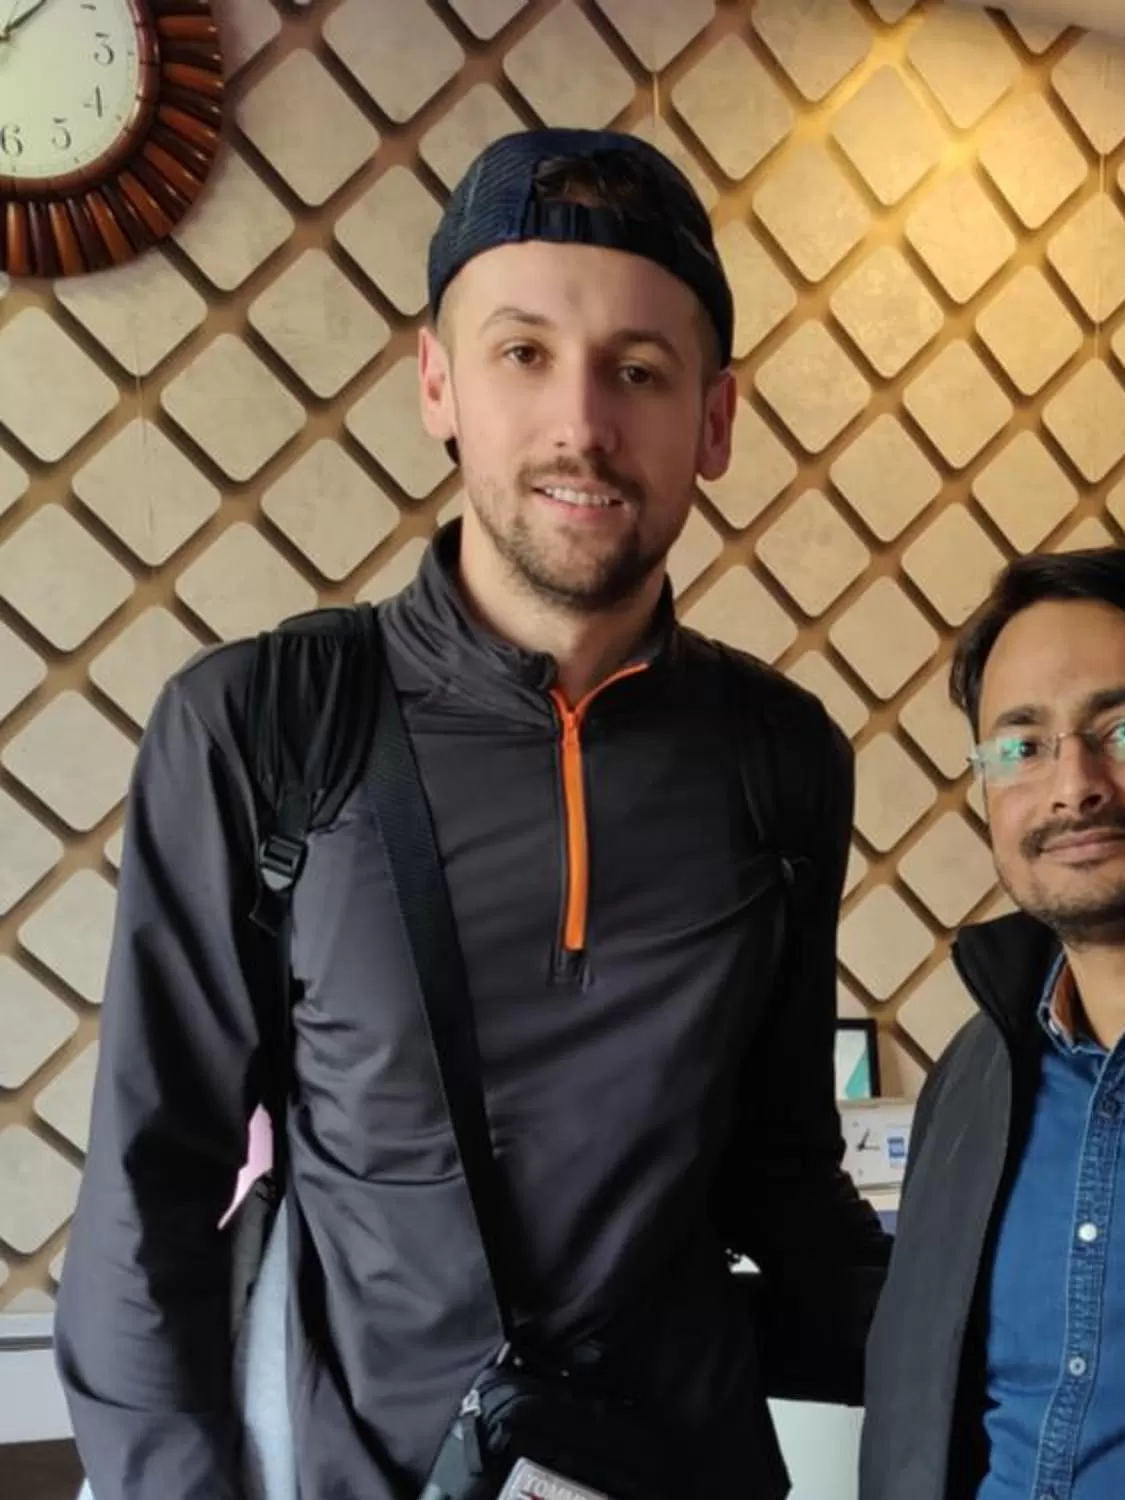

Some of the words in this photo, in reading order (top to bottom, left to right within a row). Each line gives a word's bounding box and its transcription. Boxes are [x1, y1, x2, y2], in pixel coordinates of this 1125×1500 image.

[93, 31, 115, 65] 3
[83, 85, 103, 119] 4
[0, 124, 24, 157] 6
[51, 117, 72, 150] 5
